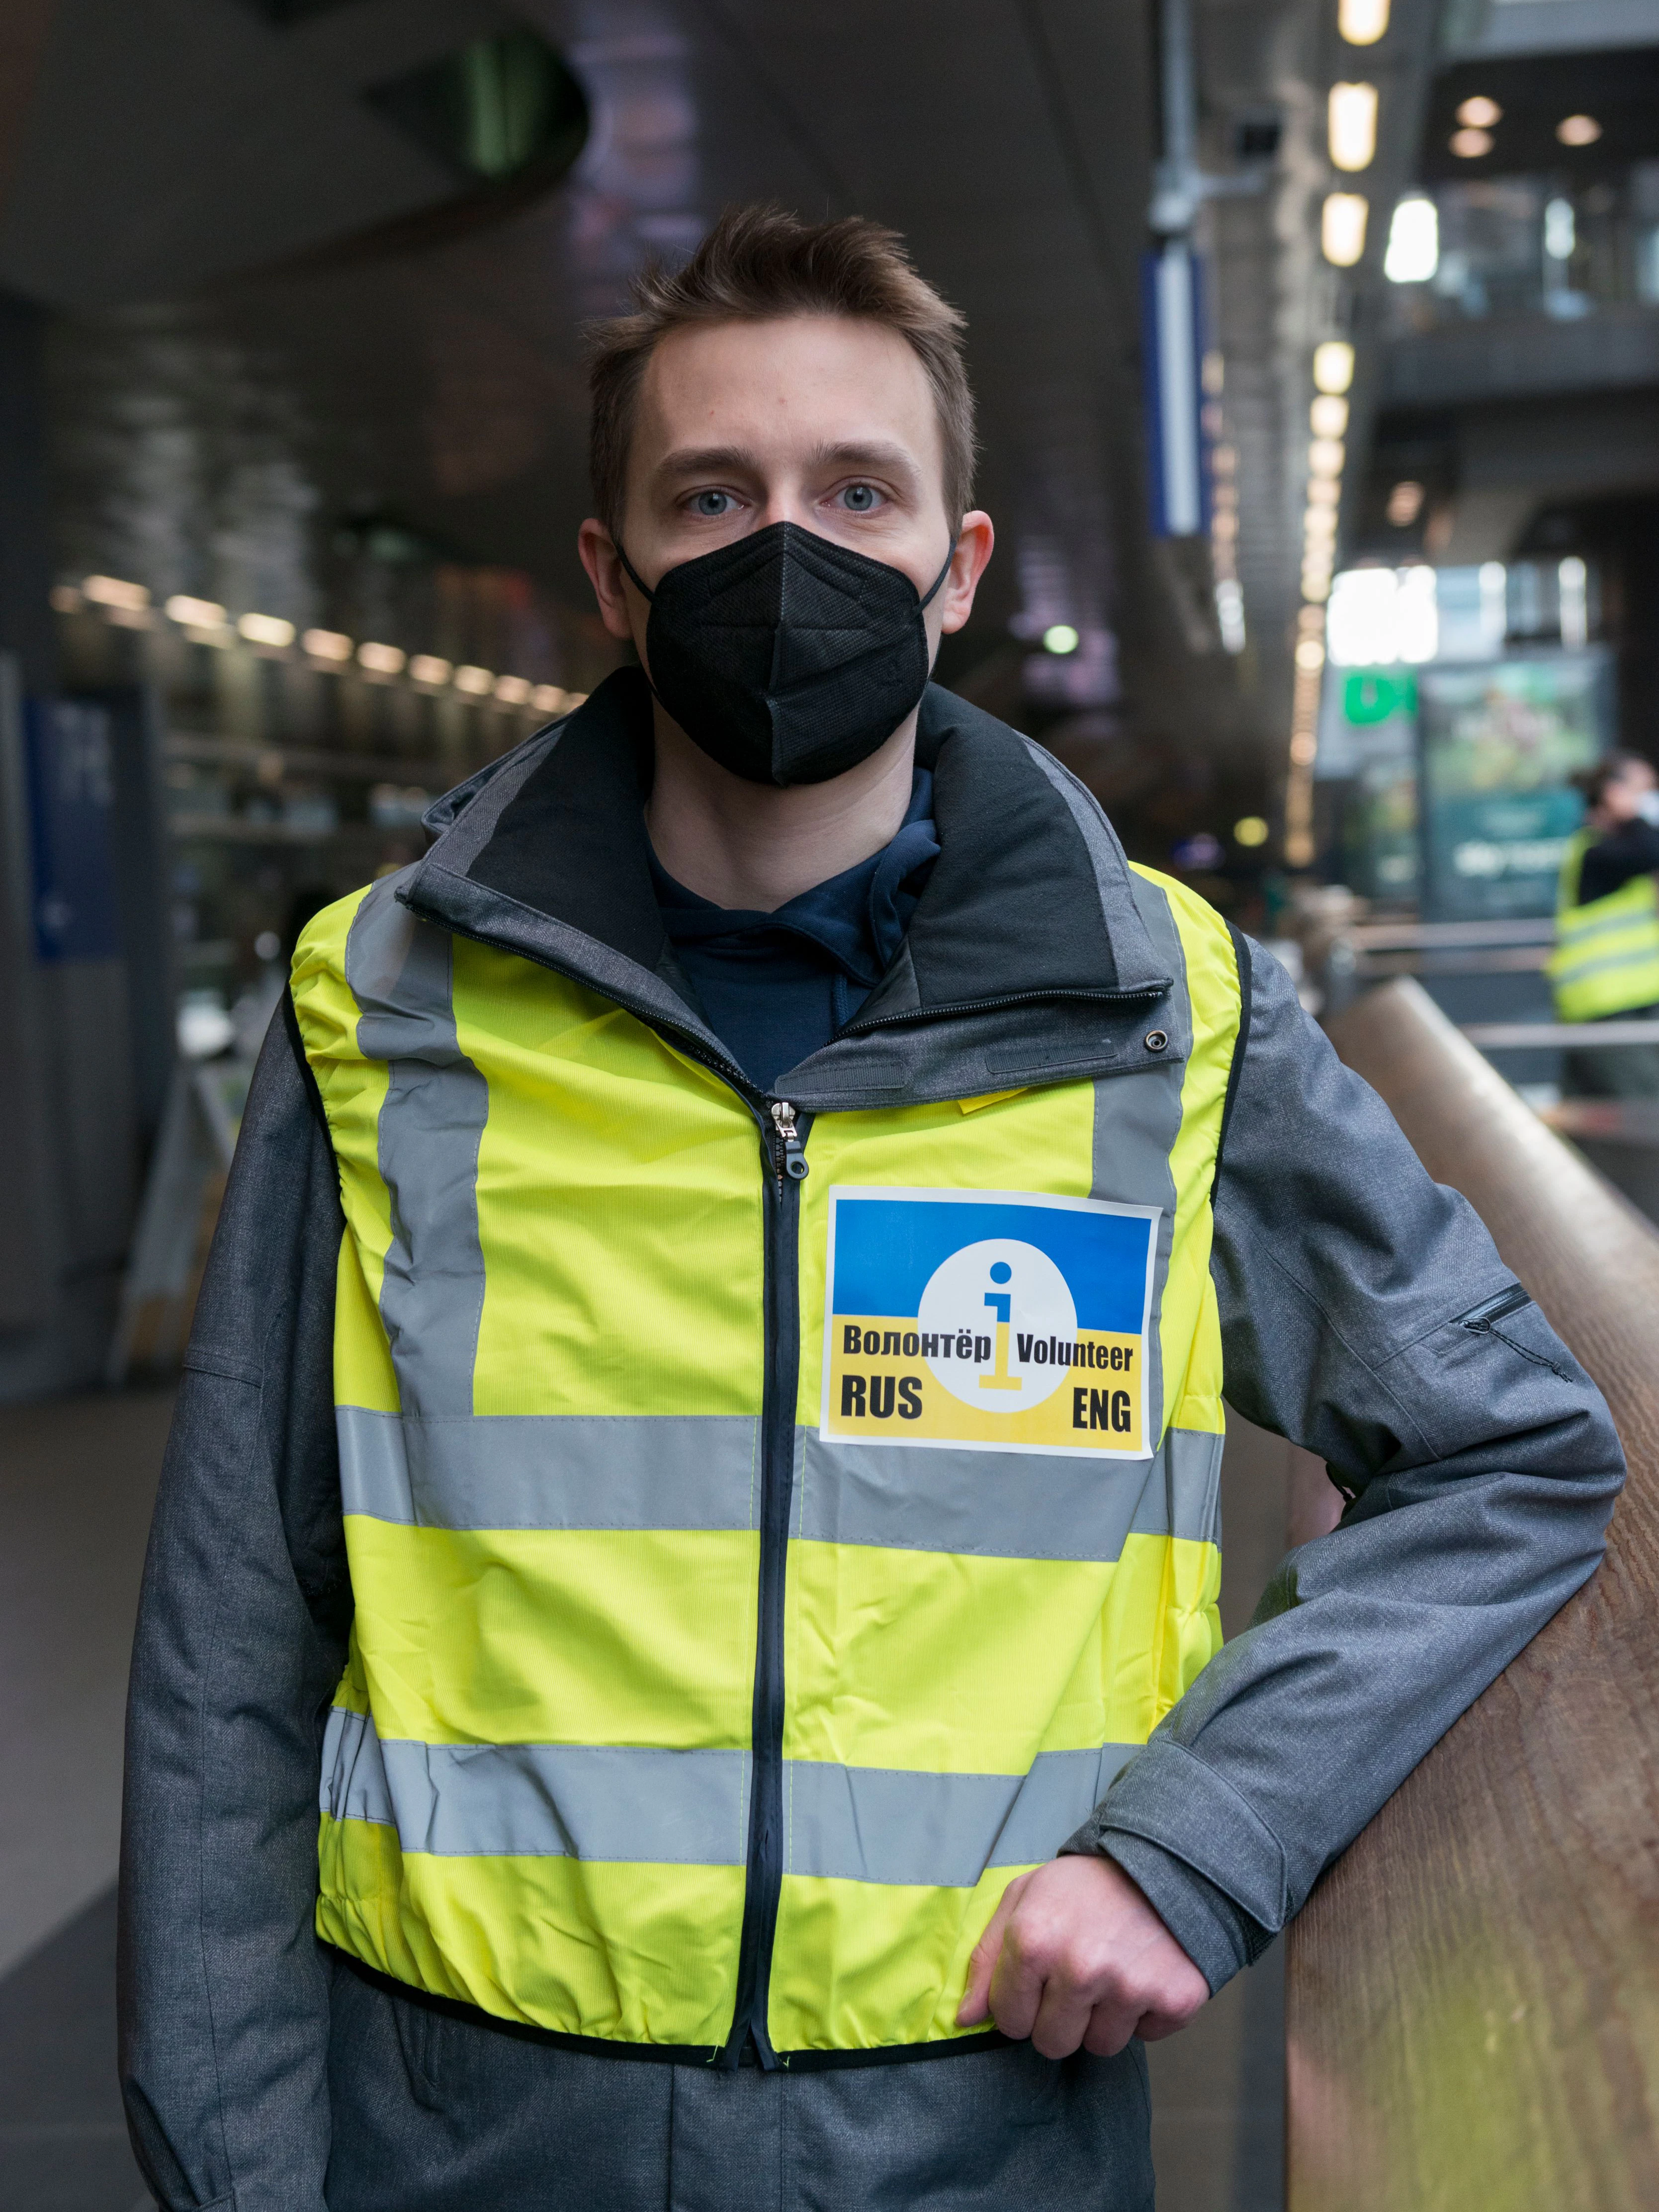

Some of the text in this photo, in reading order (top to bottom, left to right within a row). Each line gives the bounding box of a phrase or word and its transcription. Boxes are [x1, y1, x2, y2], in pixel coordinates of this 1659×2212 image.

[844, 1325, 991, 1362] Волонтёр
[1017, 1334, 1133, 1371] Volunteer
[841, 1375, 922, 1419] RUS
[1073, 1388, 1131, 1432] ENG
